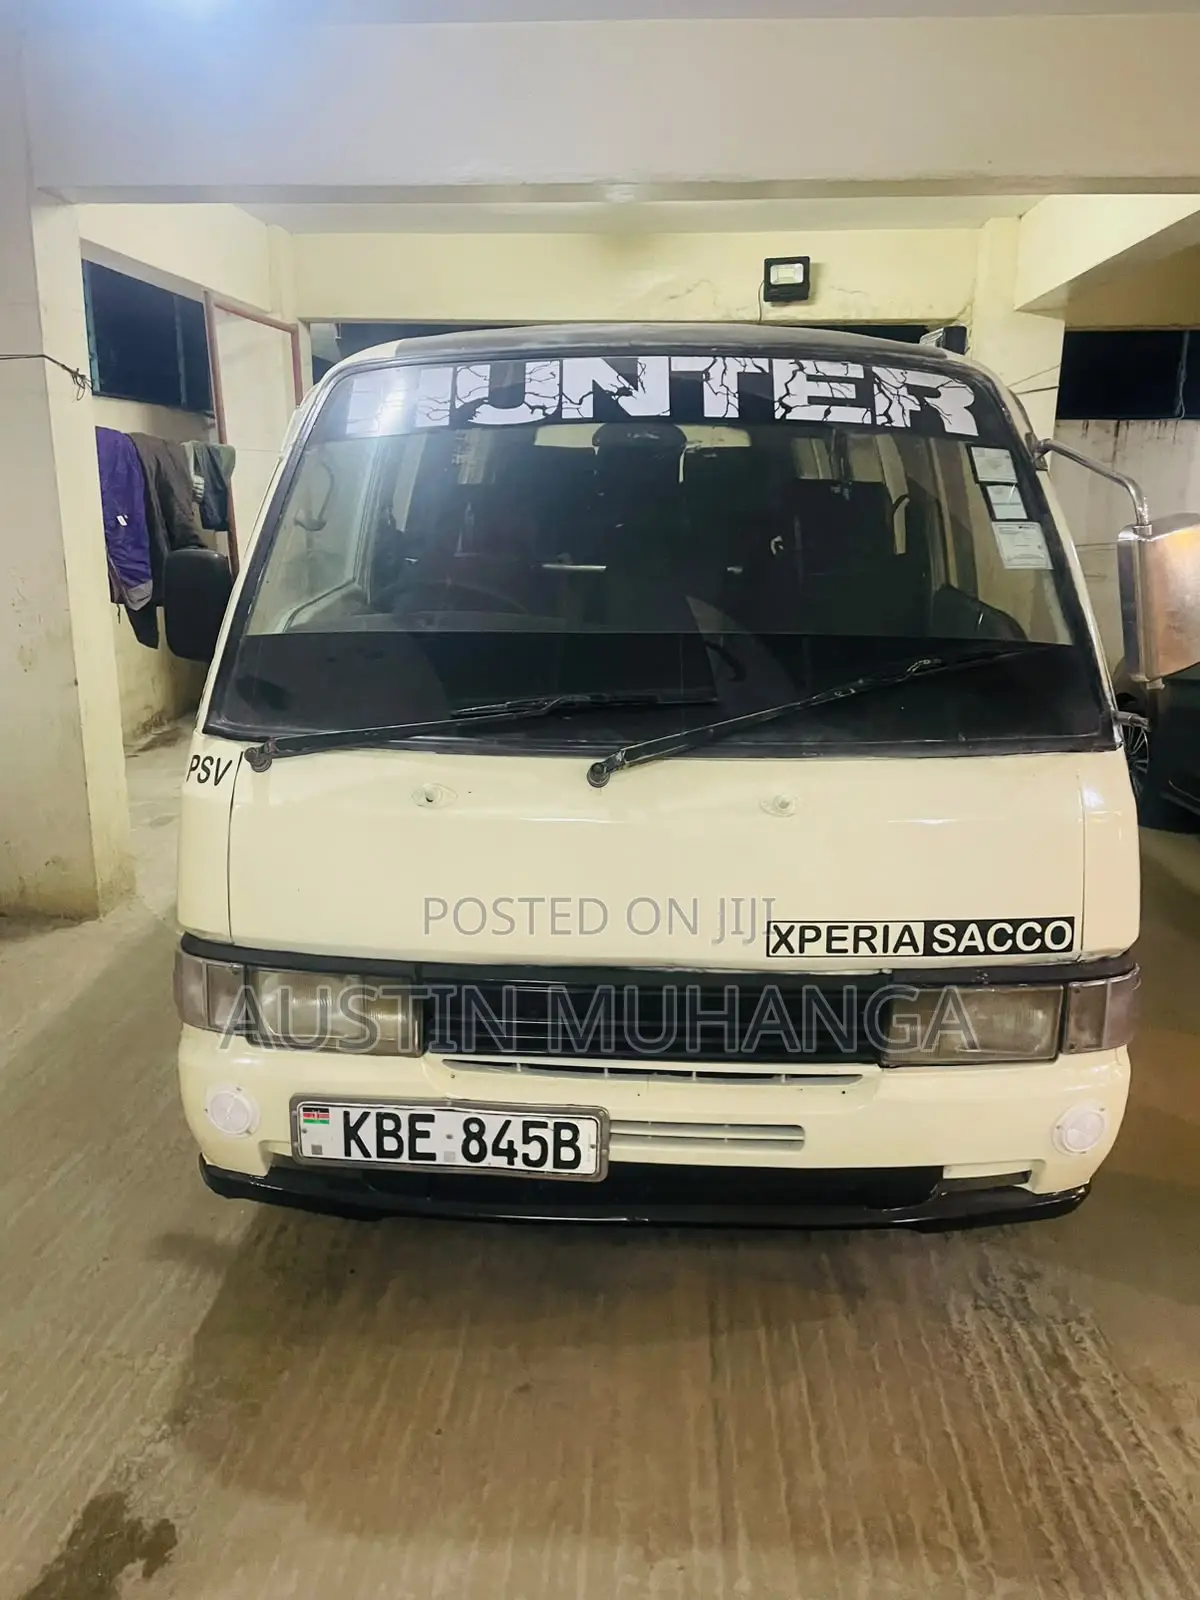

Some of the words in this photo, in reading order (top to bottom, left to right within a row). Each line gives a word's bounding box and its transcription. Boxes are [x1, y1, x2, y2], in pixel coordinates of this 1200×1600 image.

[346, 355, 979, 436] HUNTER
[186, 754, 233, 786] PSV
[771, 924, 920, 954] XPERIA
[932, 920, 1073, 954] SACCO
[343, 1110, 437, 1161] KBE
[461, 1117, 582, 1170] 845B
